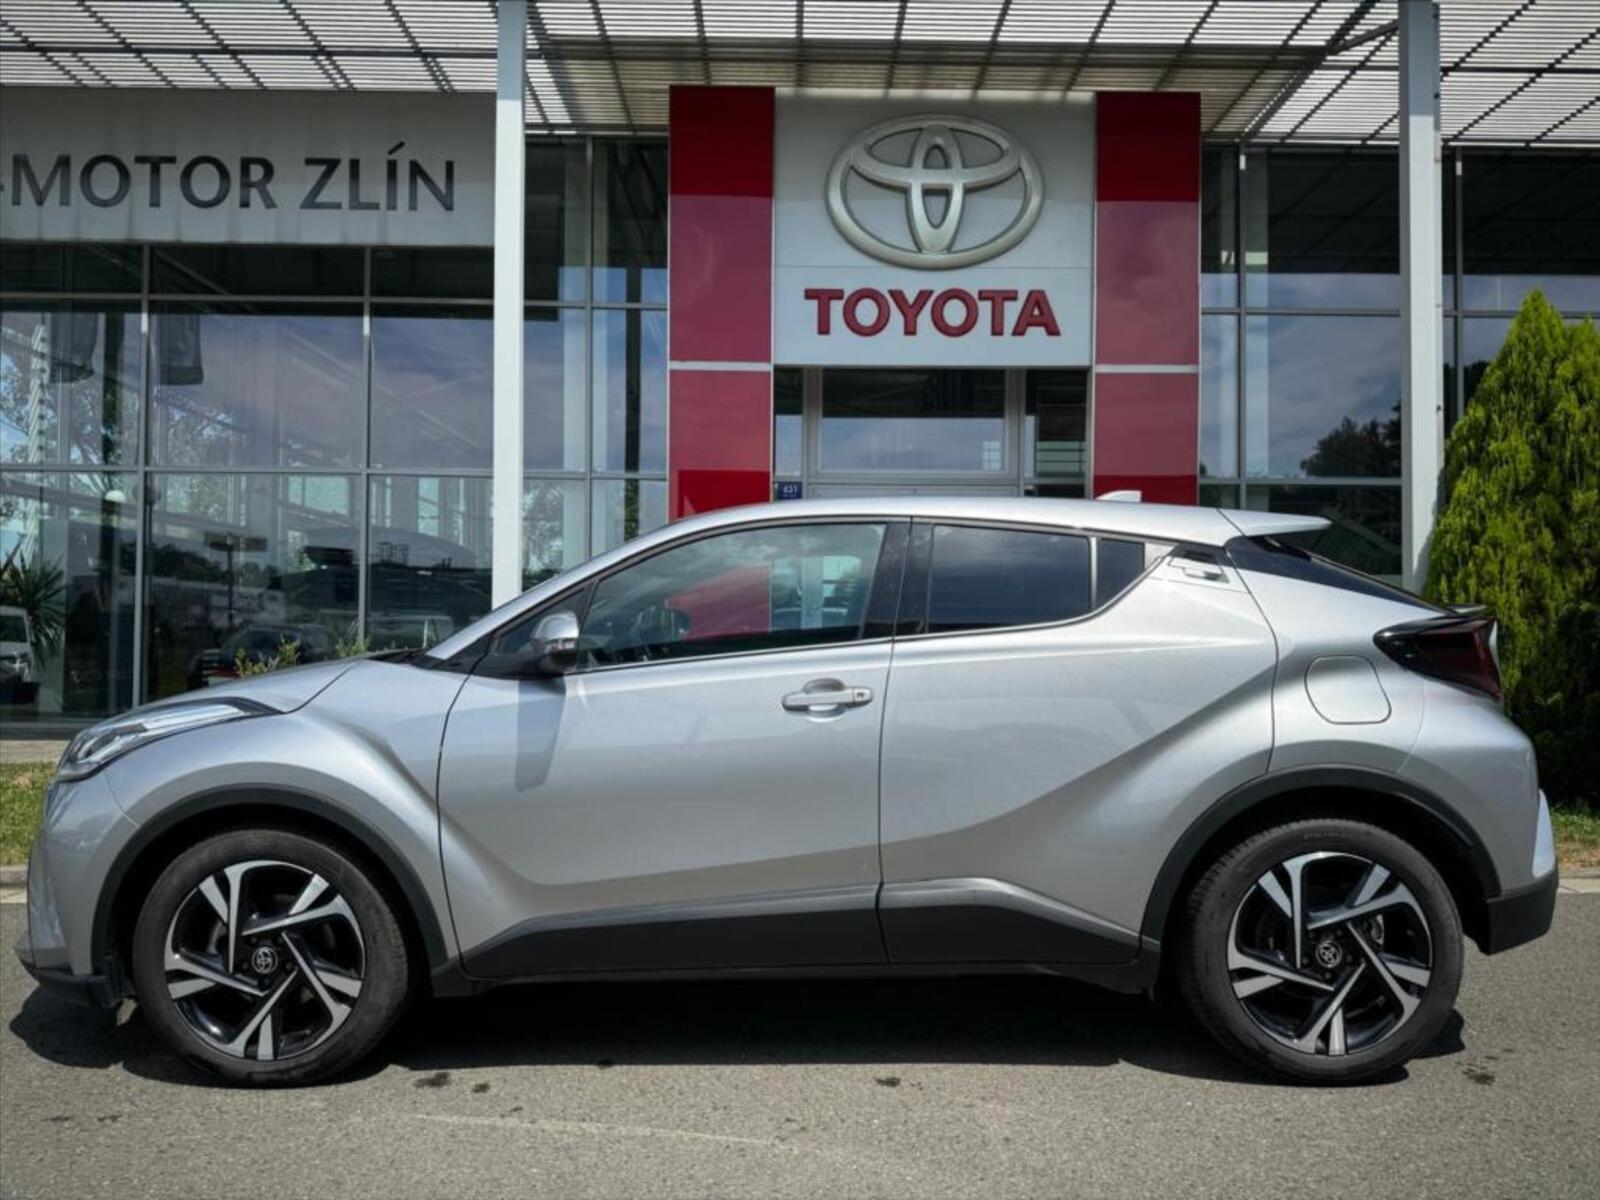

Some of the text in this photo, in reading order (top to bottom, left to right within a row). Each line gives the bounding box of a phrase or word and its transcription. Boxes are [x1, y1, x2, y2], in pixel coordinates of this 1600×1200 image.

[0, 141, 455, 211] MOTOR ZLÍN
[804, 287, 1061, 337] TOYOTA
